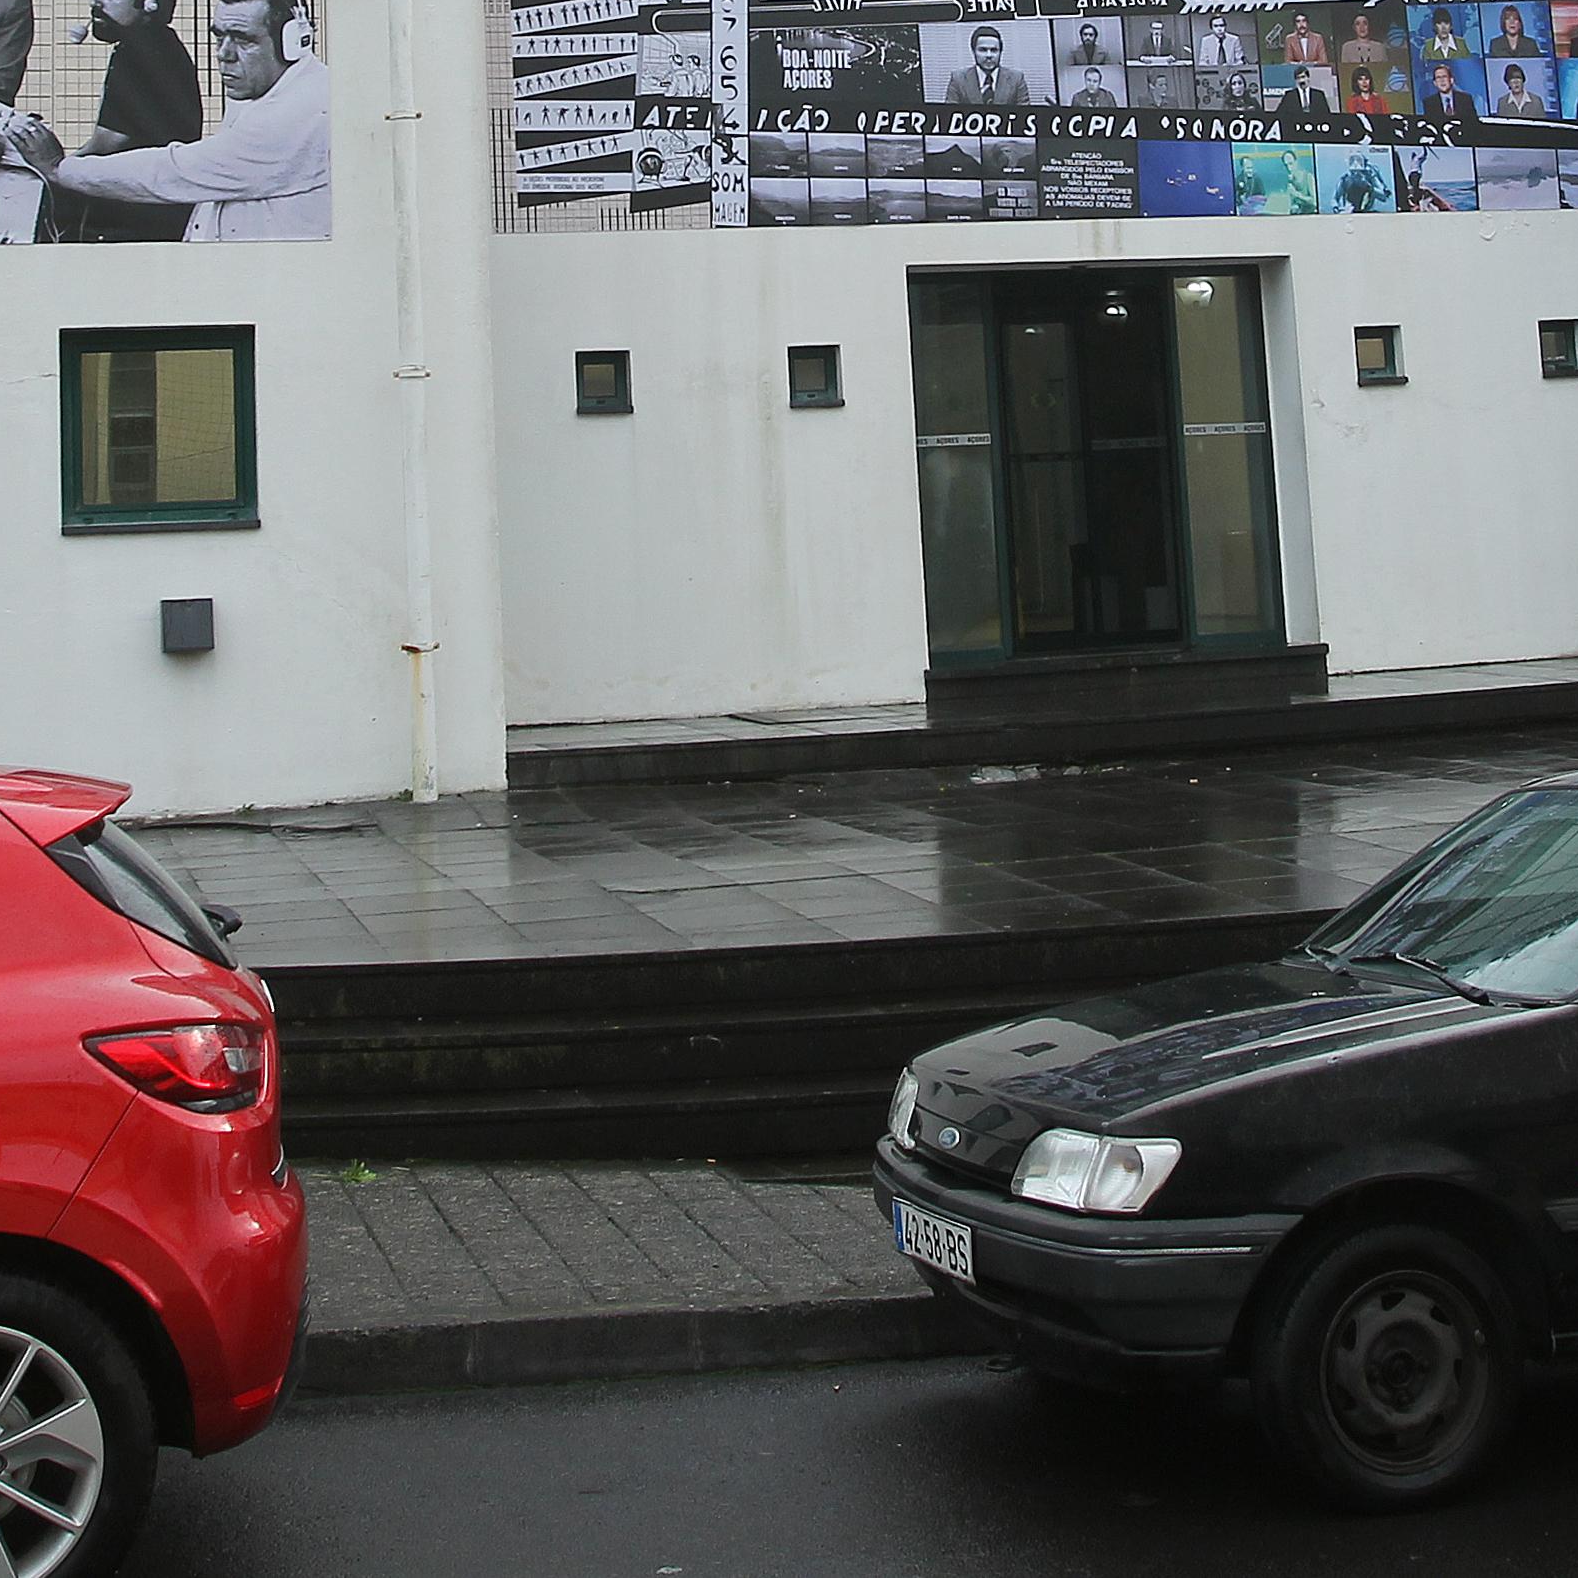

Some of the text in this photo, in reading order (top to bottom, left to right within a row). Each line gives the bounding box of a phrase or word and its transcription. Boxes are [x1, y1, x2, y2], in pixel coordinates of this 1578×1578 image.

[719, 45, 737, 71] 6
[781, 46, 853, 70] BOA-NOITE
[720, 74, 738, 100] 5
[782, 68, 834, 92] AÇORES
[712, 172, 745, 193] SOM
